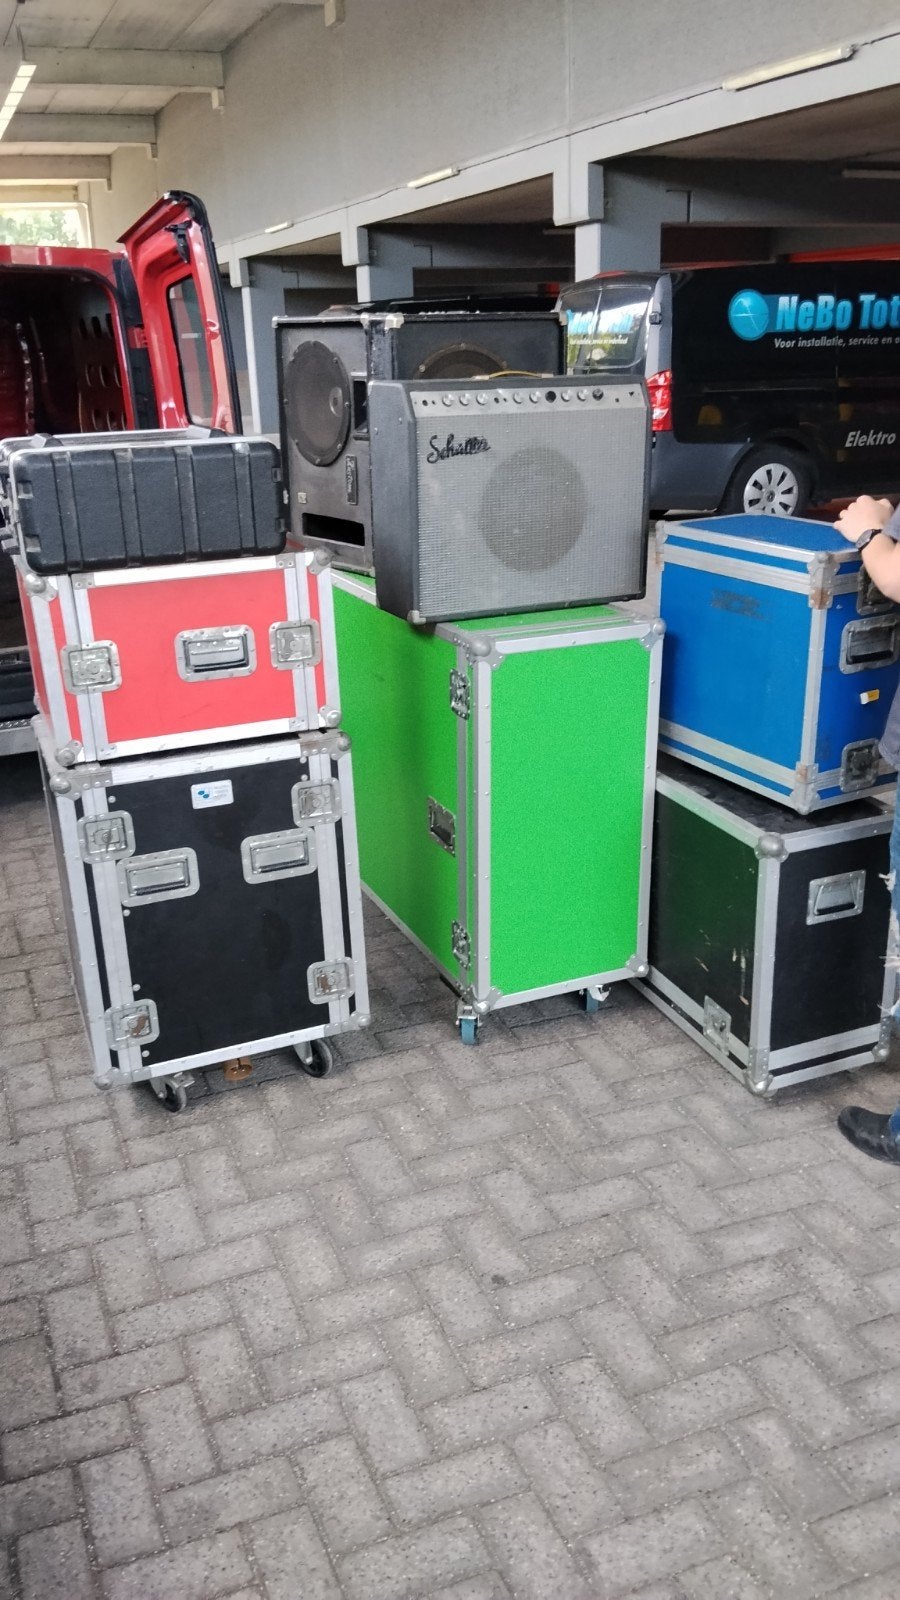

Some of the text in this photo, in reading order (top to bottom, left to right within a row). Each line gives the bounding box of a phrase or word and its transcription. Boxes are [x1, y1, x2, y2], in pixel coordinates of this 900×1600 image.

[775, 294, 853, 332] NeBo
[774, 338, 797, 349] Voor
[848, 335, 880, 346] service
[881, 336, 893, 345] en
[844, 429, 897, 448] Elektro
